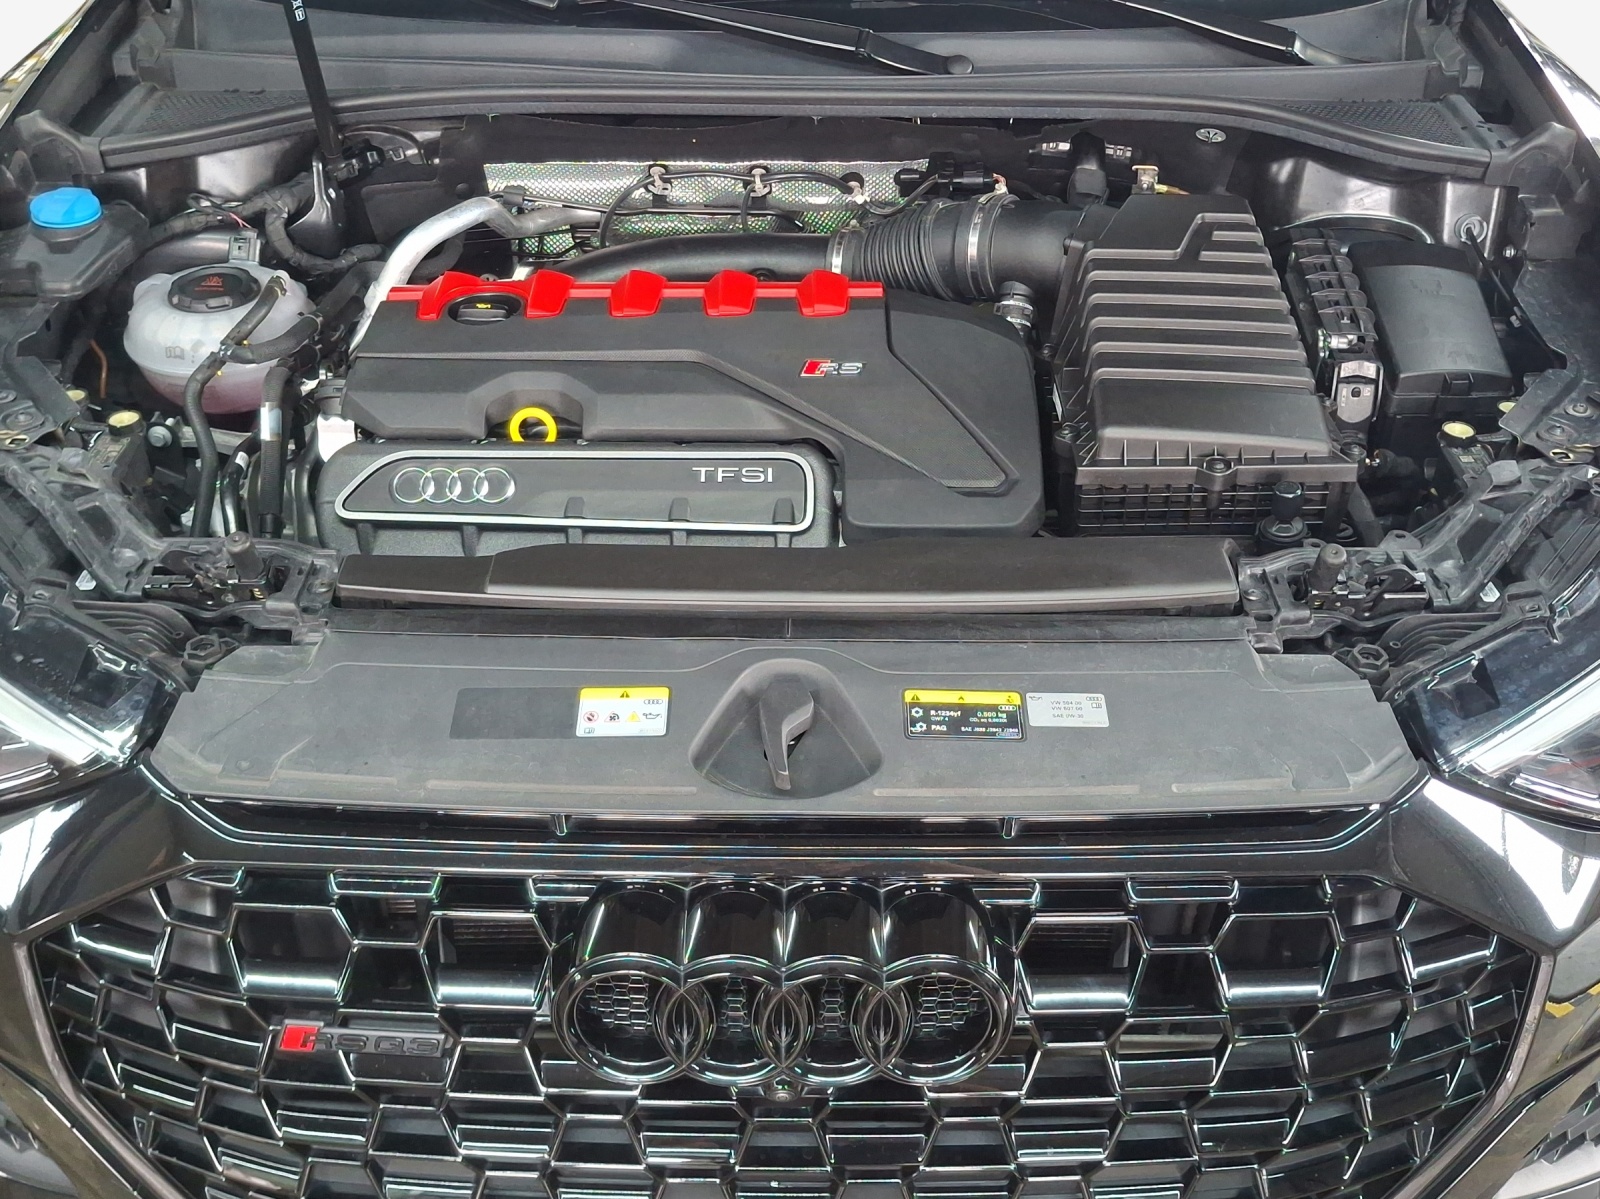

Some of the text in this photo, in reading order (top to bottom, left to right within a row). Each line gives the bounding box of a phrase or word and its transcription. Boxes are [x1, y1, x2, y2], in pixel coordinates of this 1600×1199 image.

[804, 360, 863, 376] RS
[691, 467, 773, 483] TFSI
[294, 1027, 369, 1051] RS
